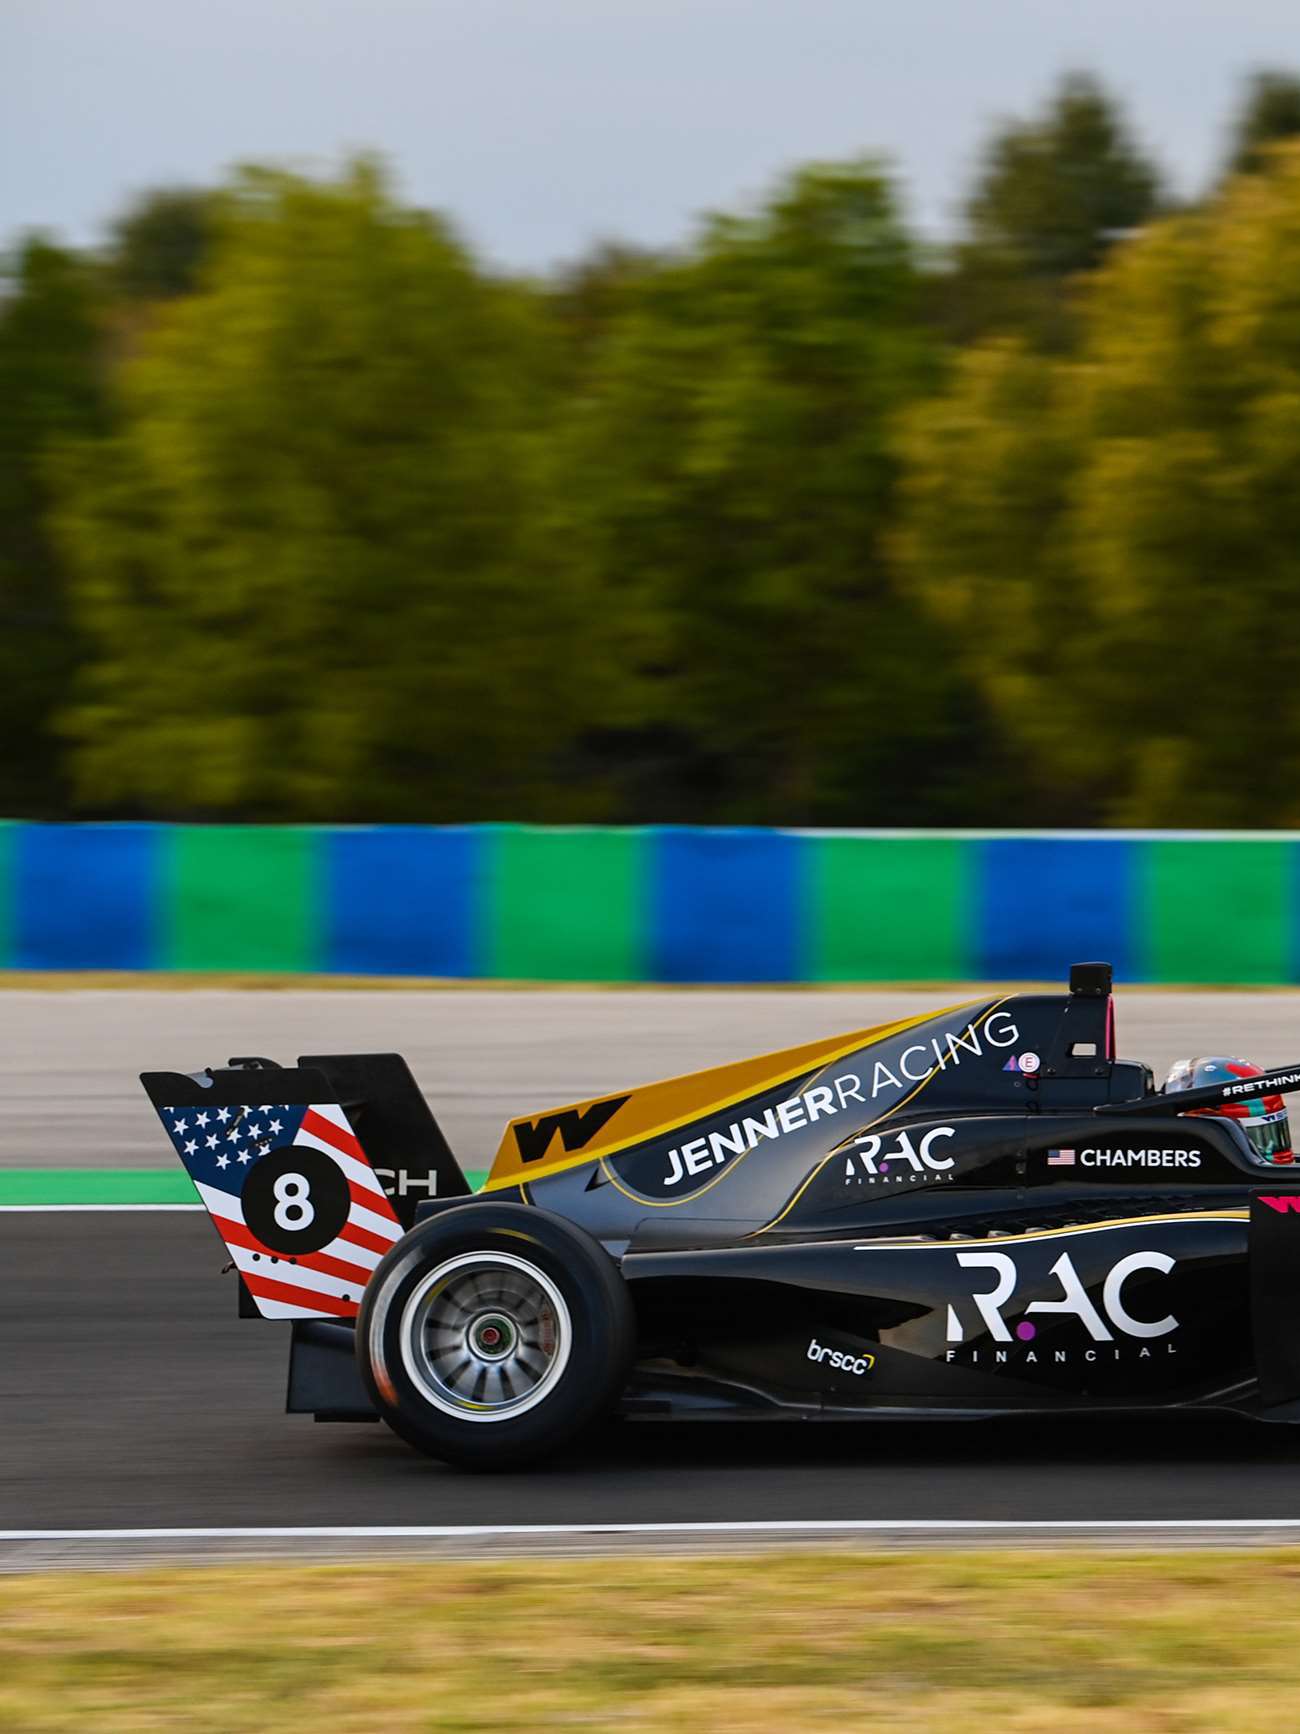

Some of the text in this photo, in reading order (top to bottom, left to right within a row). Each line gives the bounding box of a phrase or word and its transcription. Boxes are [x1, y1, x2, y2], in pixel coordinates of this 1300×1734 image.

[846, 1127, 956, 1176] RAC
[1080, 1149, 1201, 1168] CHAMBERS
[845, 1174, 954, 1185] FINANCIAL
[273, 1172, 315, 1232] 8
[946, 1251, 1180, 1342] RAC
[946, 1344, 1177, 1363] FINANCIAL
